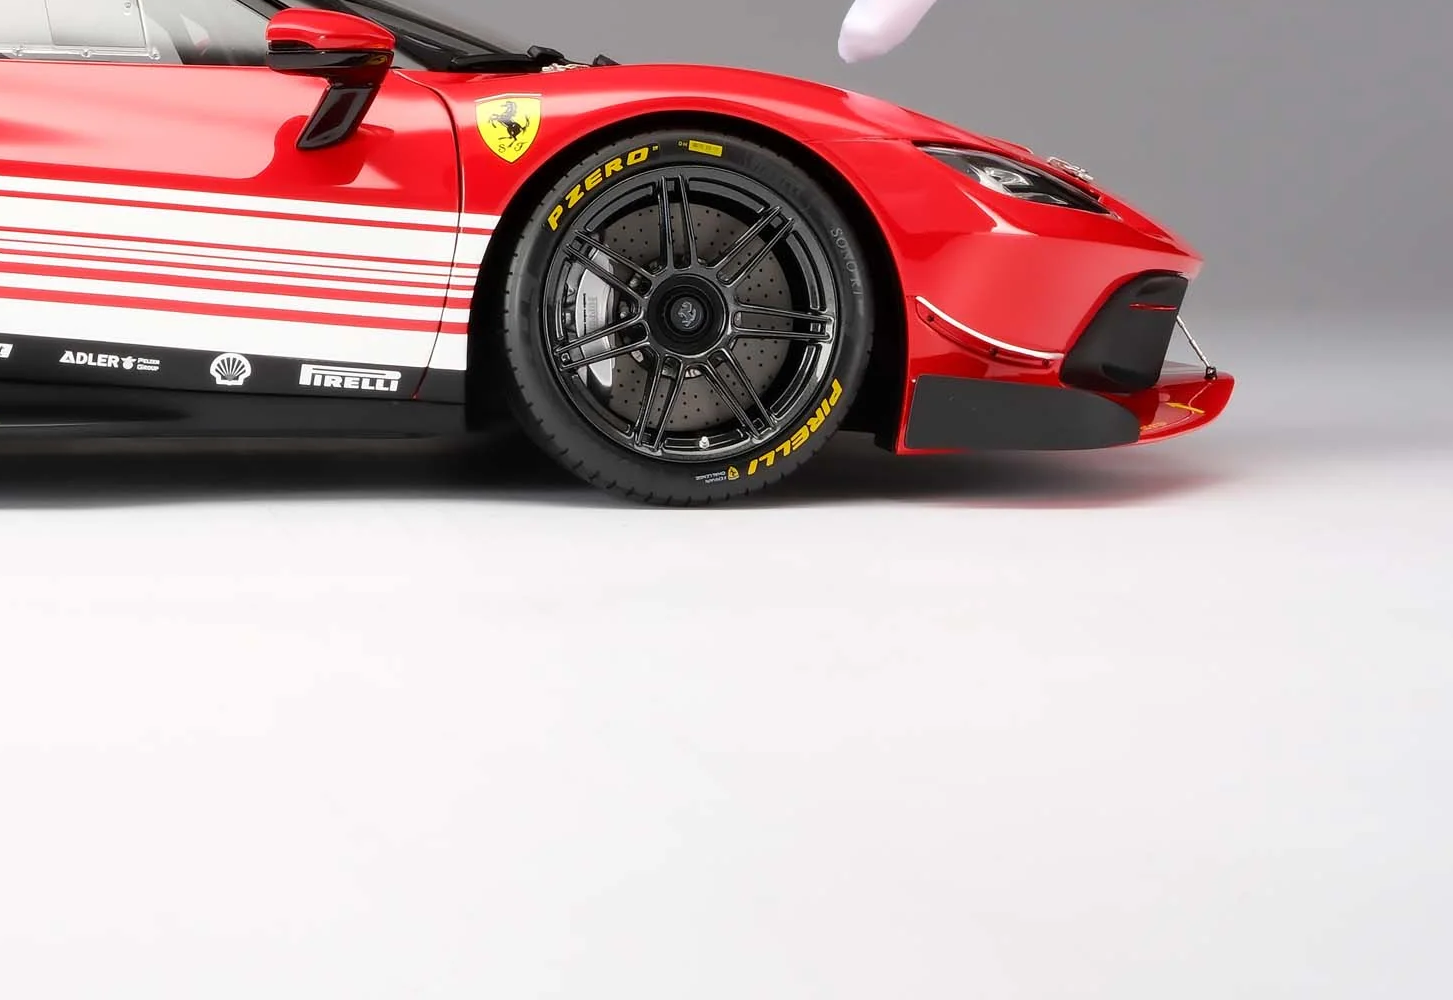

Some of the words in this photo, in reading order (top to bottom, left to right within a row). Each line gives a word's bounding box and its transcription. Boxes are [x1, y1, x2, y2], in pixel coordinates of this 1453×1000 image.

[59, 350, 119, 369] ADLER
[299, 363, 402, 392] PIRELLI
[747, 378, 843, 476] PIRELLI
